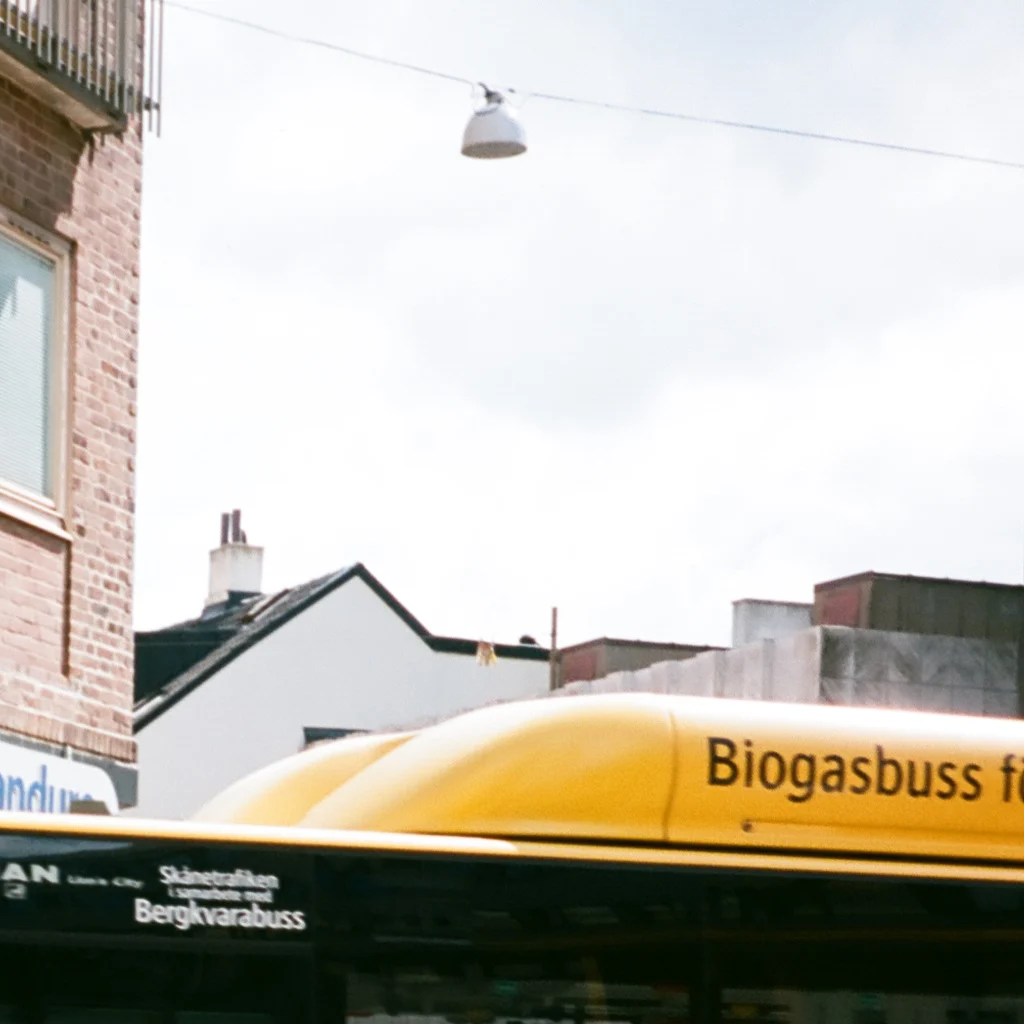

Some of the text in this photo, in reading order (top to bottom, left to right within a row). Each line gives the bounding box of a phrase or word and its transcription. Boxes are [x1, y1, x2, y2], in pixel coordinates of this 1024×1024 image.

[708, 736, 1024, 803] Biogasbuss f
[134, 897, 306, 931] Bergkvarabuss
